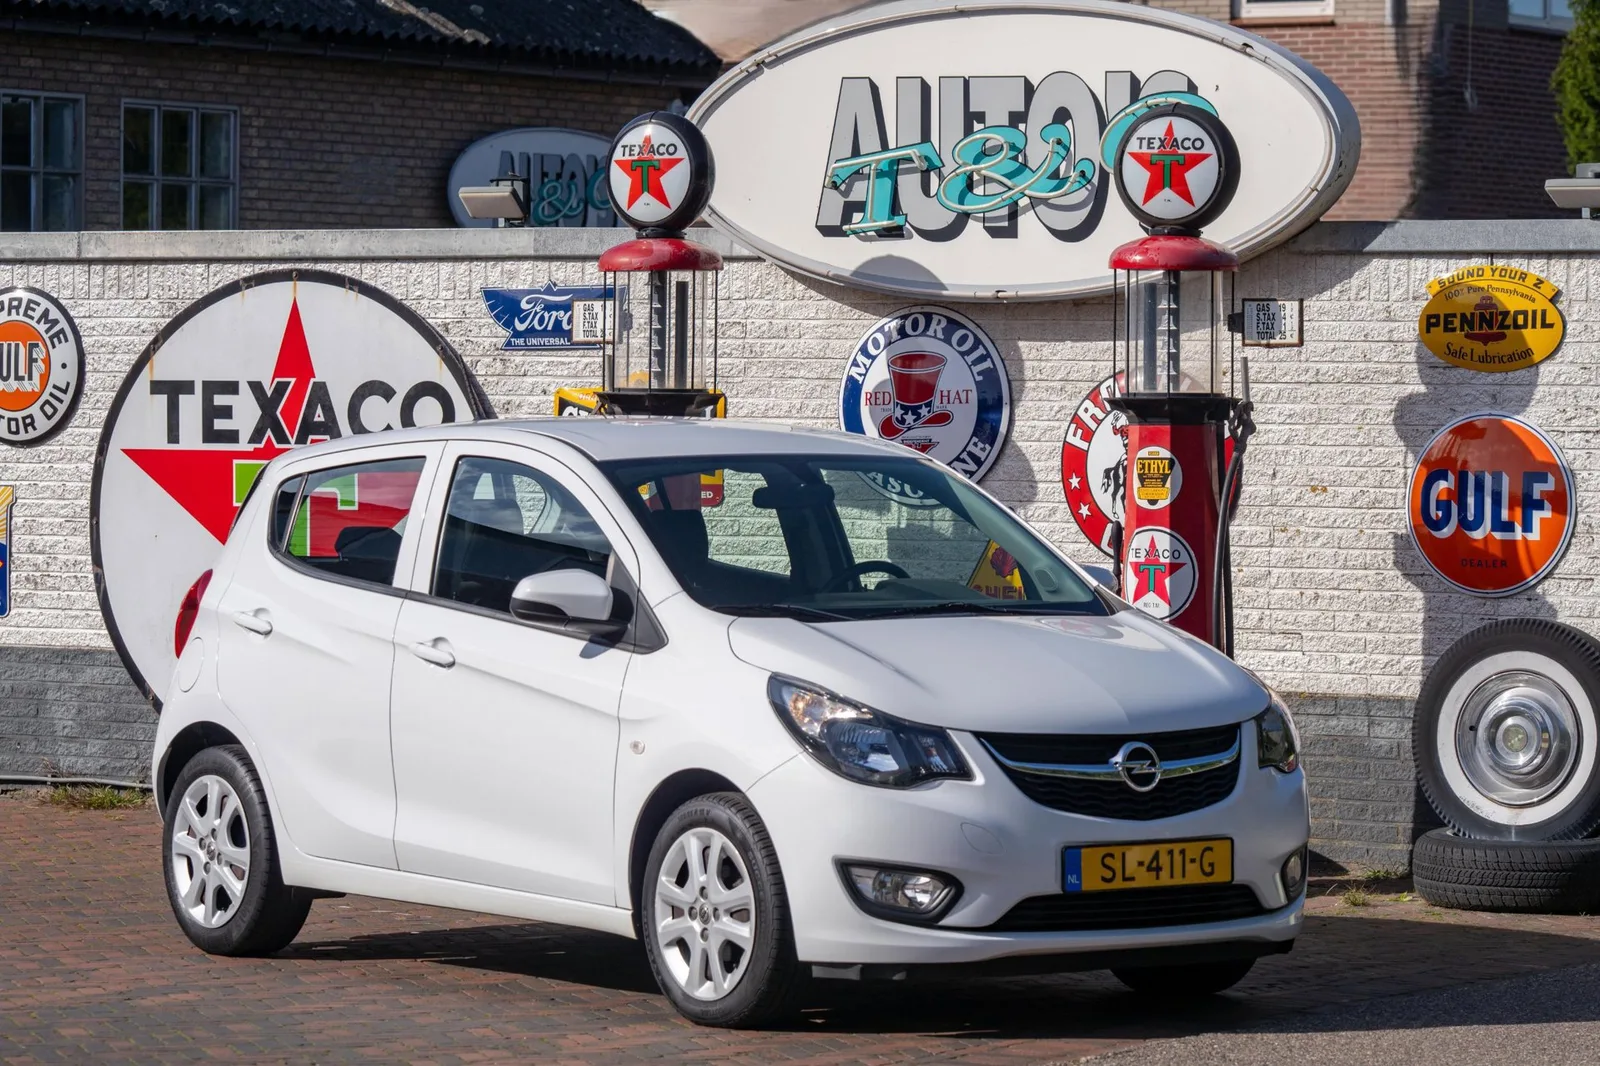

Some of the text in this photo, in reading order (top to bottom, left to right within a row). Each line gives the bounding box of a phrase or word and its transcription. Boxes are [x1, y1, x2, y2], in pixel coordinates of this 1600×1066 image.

[621, 144, 678, 157] TEXACO
[1136, 136, 1205, 151] TEXACO
[631, 160, 661, 194] T
[1150, 153, 1186, 190] T
[1437, 267, 1485, 289] SOUND
[1490, 267, 1528, 283] YOUR
[1467, 285, 1486, 294] Pure
[1486, 284, 1536, 304] Pennsylvania
[583, 303, 595, 312] GAS
[1256, 303, 1270, 312] GAS
[583, 312, 599, 321] S.TAX
[1256, 312, 1276, 321] S.TAX
[1425, 309, 1555, 334] PENNZOIL
[583, 321, 598, 329] F.TAX
[1256, 322, 1275, 331] F.TAX
[510, 337, 571, 346] THE UNIVERSAL
[583, 329, 599, 339] TOTAL
[1256, 331, 1276, 340] TOTAL
[849, 313, 994, 385] MOTOR OIL
[1444, 341, 1535, 364] Safe Lubrication
[39, 380, 71, 421] OIL
[864, 391, 892, 406] RED
[939, 389, 973, 405] HAT
[149, 379, 456, 445] TEXACO
[1137, 459, 1171, 474] ETHYL
[1421, 468, 1555, 542] GULF
[1131, 548, 1181, 560] TEXACO
[1461, 558, 1508, 569] DEALER
[1139, 564, 1166, 593] T
[1100, 846, 1215, 884] SL-411-G
[1067, 874, 1080, 884] NL
